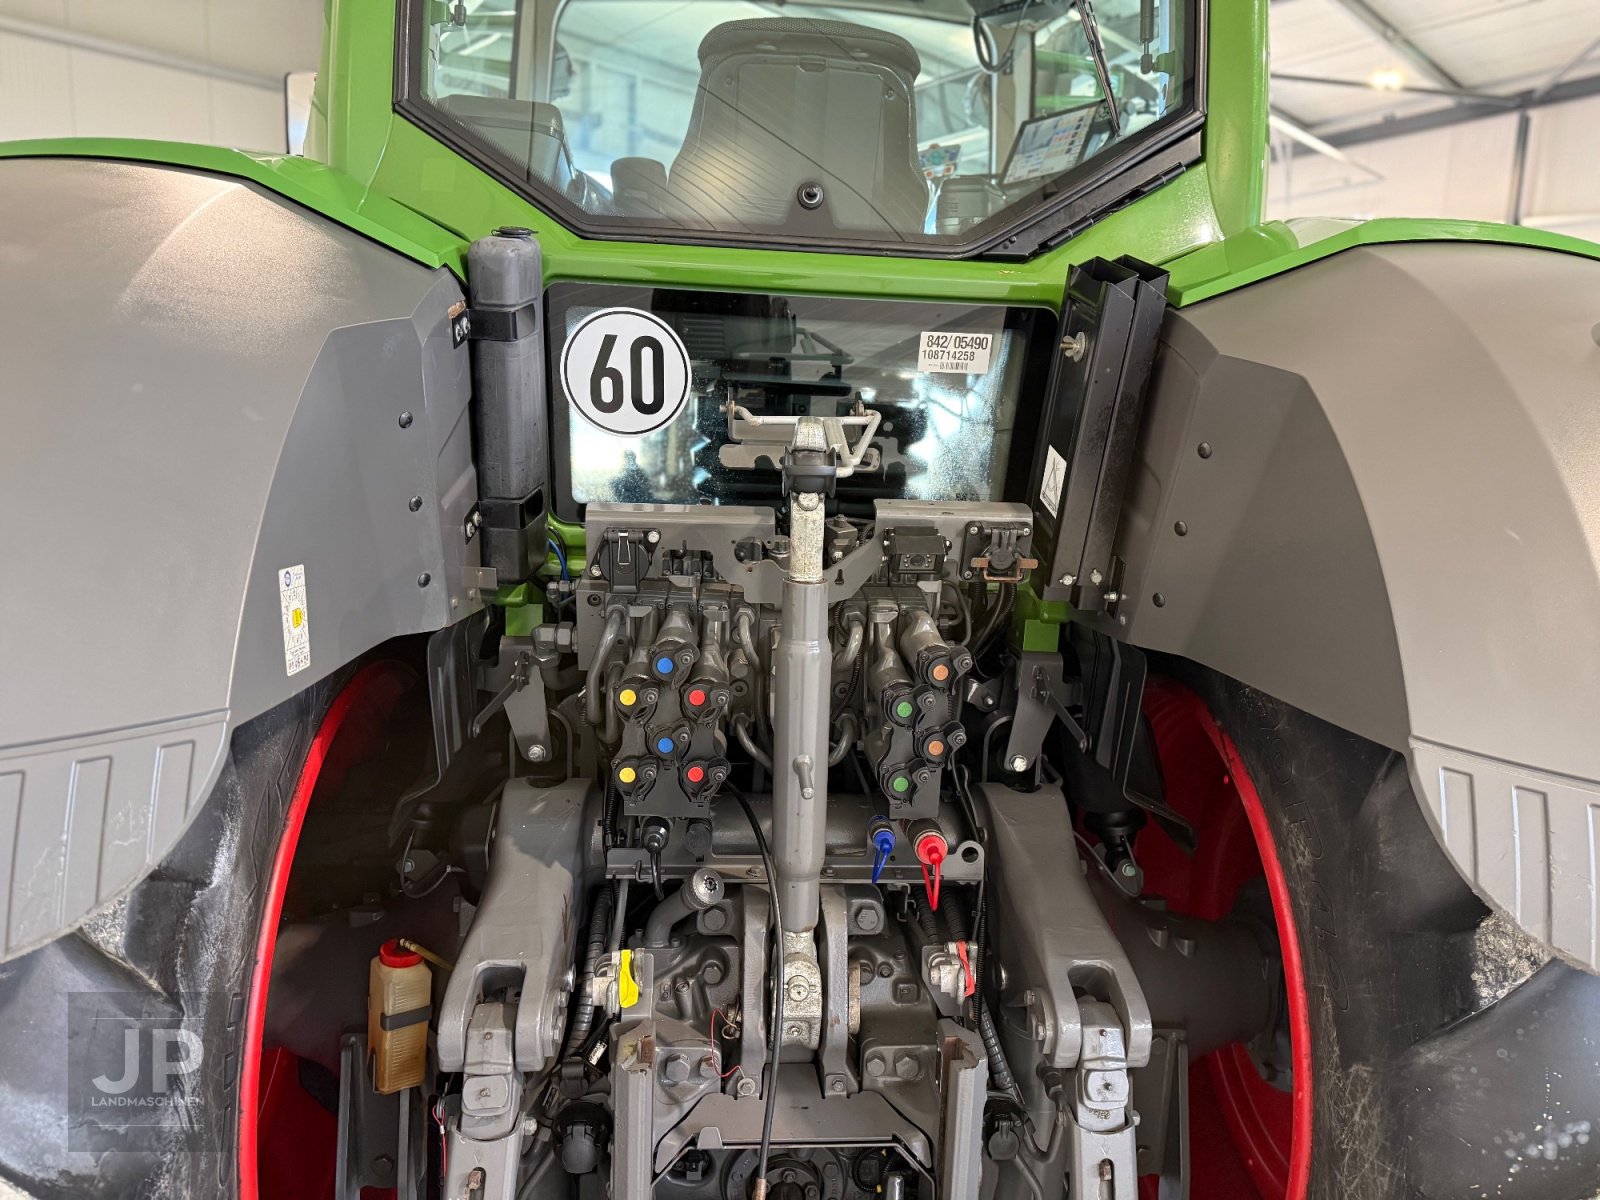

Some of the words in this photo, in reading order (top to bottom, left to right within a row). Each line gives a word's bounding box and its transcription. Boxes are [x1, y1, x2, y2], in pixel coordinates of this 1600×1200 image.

[926, 334, 989, 350] 842/05490
[922, 349, 975, 361] 108714258
[590, 333, 665, 415] 60
